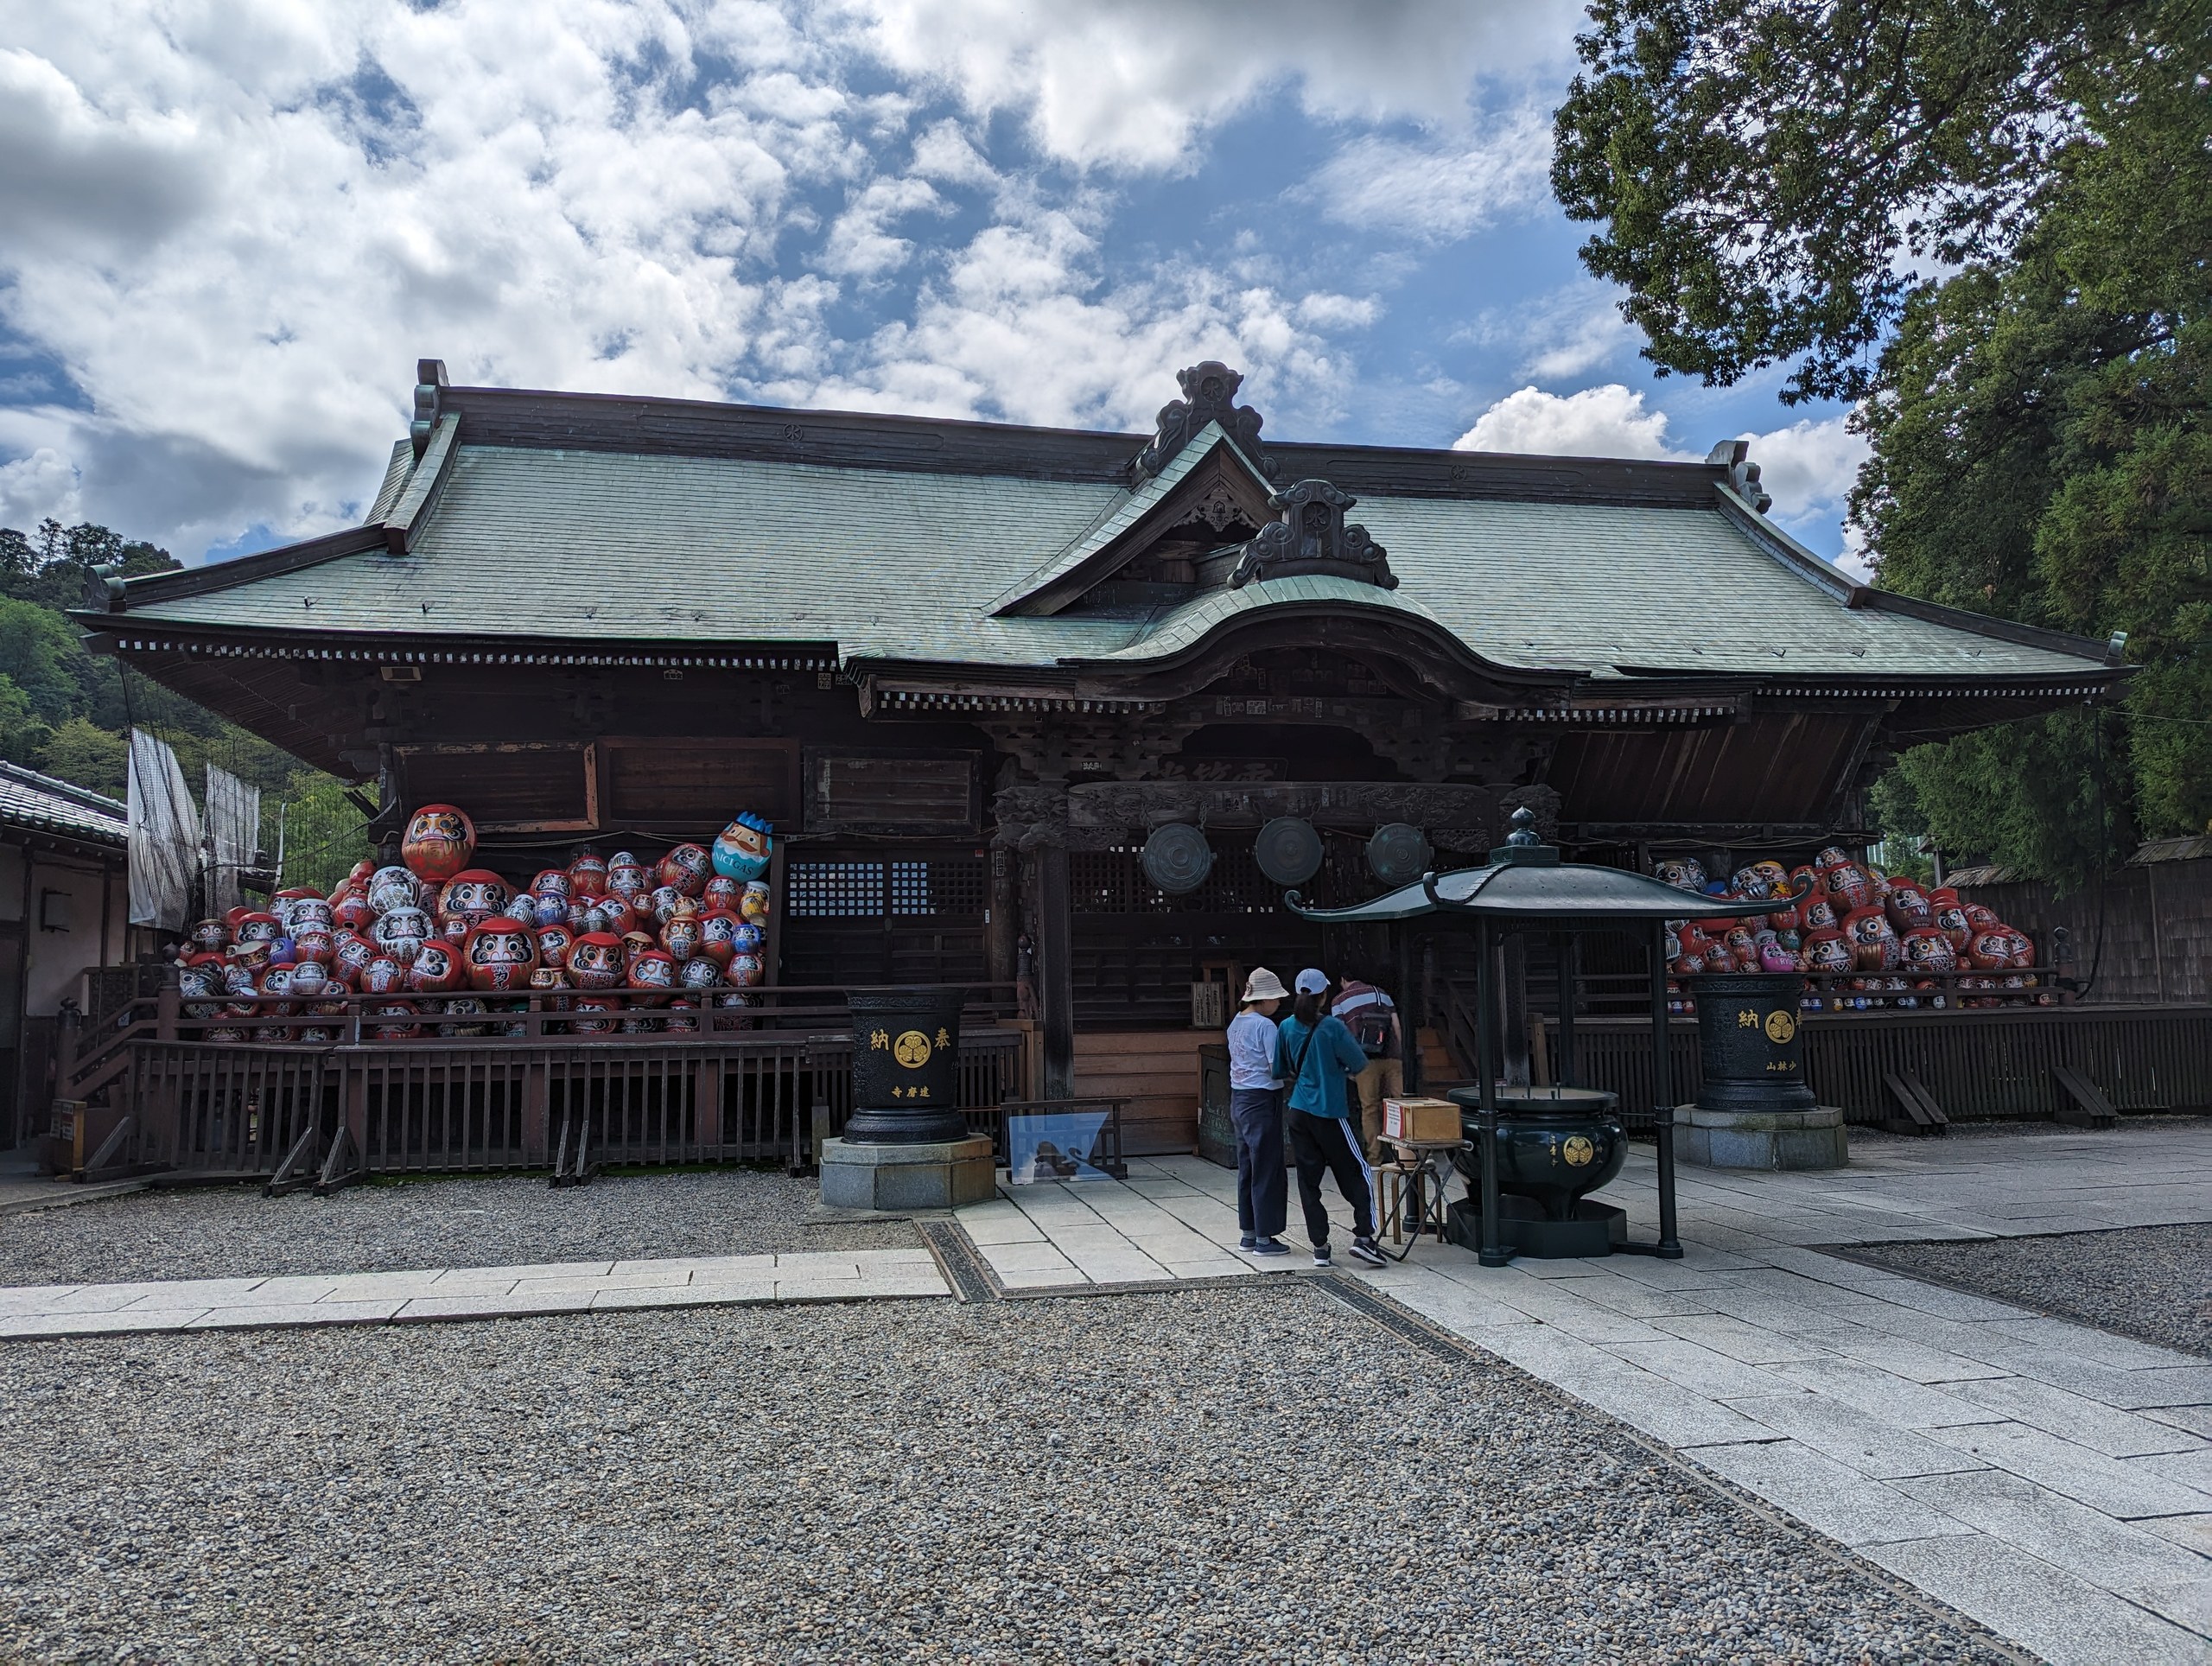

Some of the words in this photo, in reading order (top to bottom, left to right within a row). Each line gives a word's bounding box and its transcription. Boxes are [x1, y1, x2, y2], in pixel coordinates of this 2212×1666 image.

[715, 852, 754, 875] NICIGAS
[1916, 906, 1928, 916] W
[1738, 1008, 1759, 1029] 納
[870, 1028, 890, 1051] 納
[934, 1027, 951, 1051] 奉
